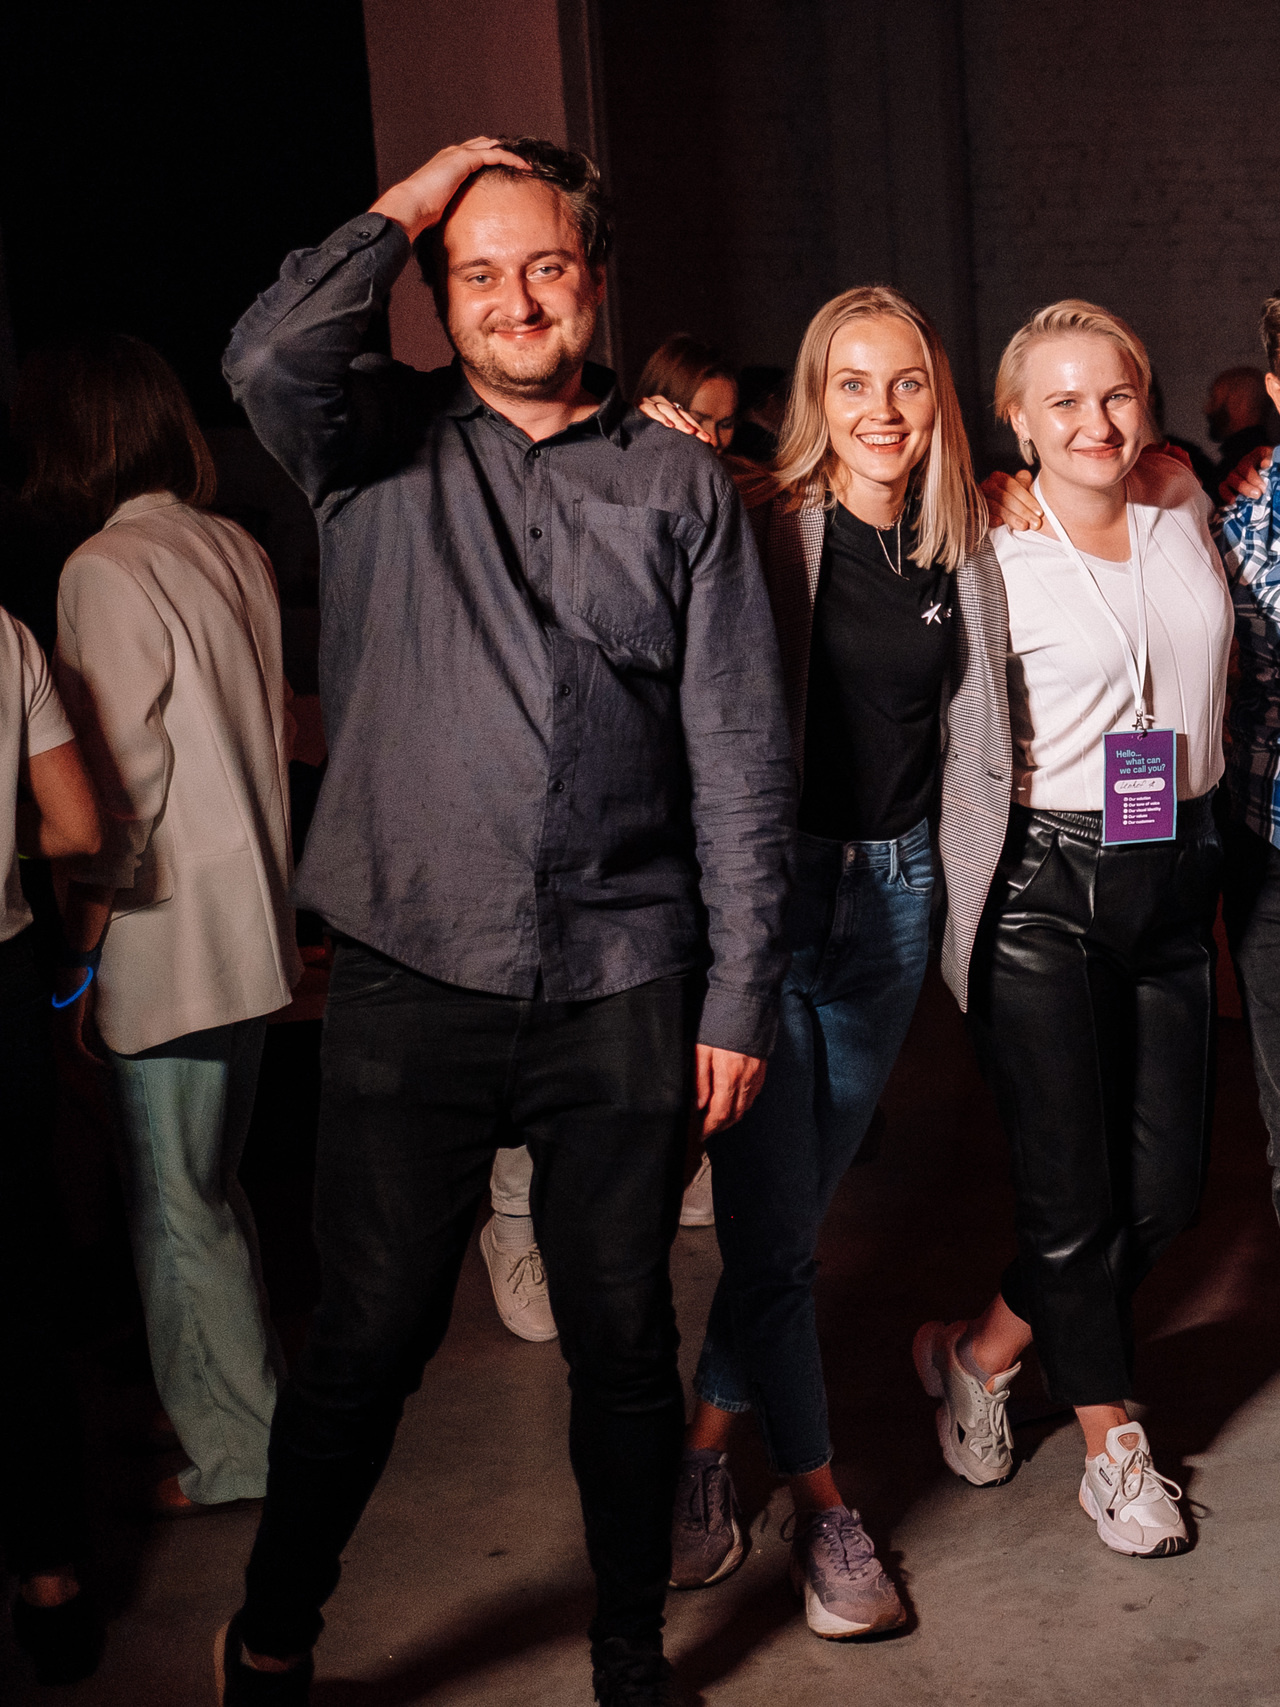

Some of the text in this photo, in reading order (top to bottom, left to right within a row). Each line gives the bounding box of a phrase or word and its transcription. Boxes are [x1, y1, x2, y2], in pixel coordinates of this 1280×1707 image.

[1116, 750, 1142, 758] Hello...
[1133, 765, 1146, 773] call
[1148, 763, 1165, 774] you?
